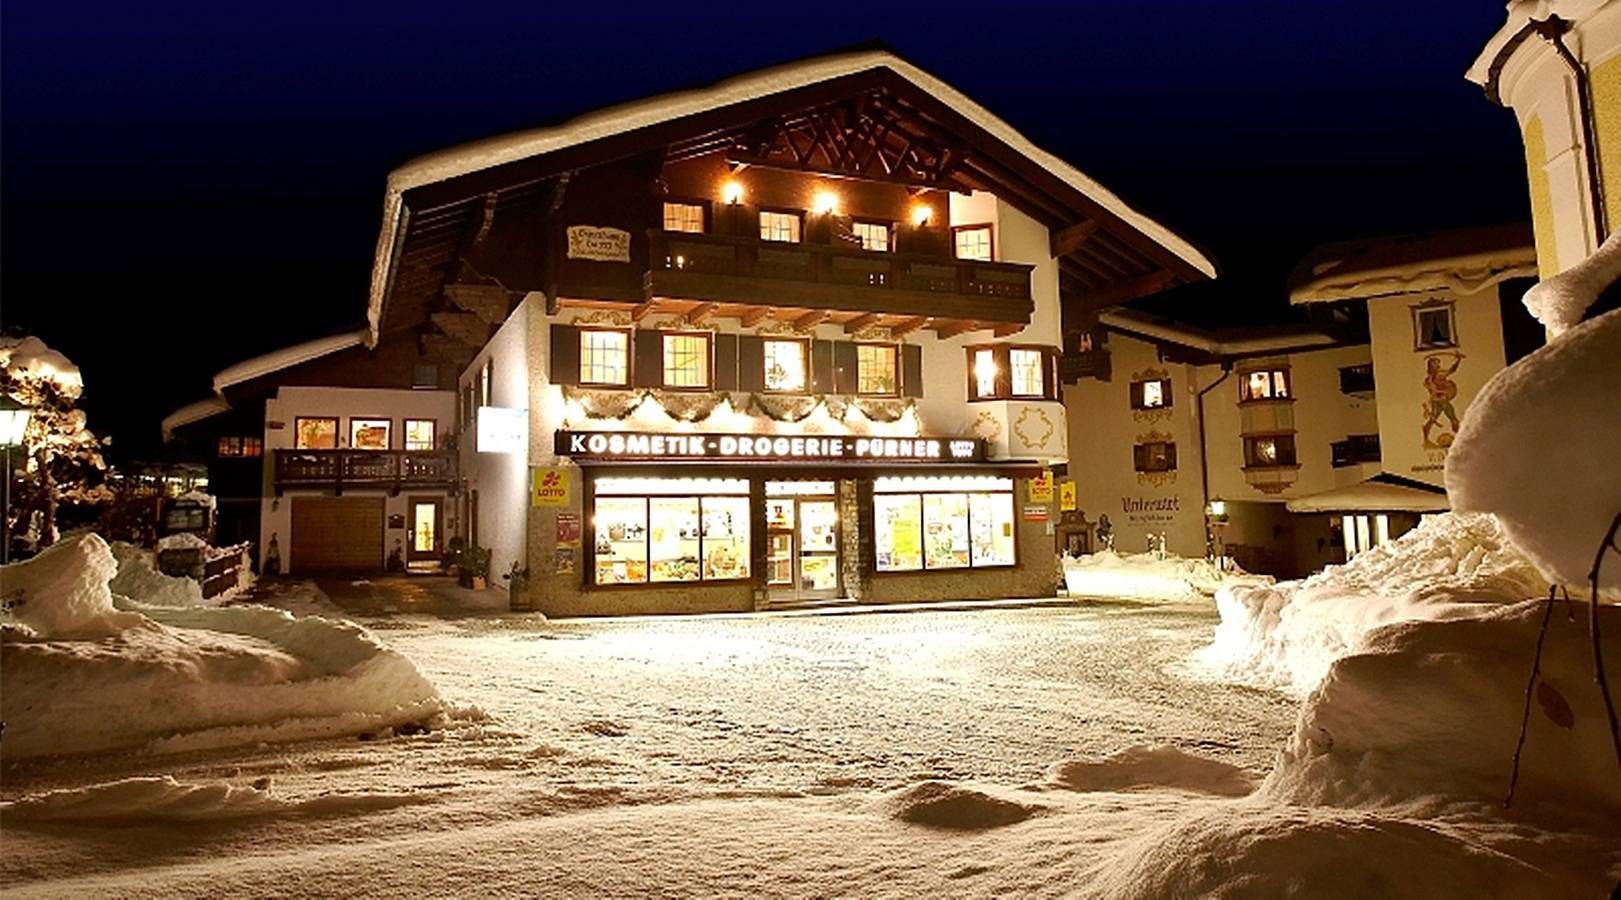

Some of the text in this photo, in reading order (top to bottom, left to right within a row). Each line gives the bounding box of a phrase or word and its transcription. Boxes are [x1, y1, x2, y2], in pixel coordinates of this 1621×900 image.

[570, 434, 940, 457] KOSMETIK DROGERIE PÜRNER
[537, 488, 566, 497] LOTTO
